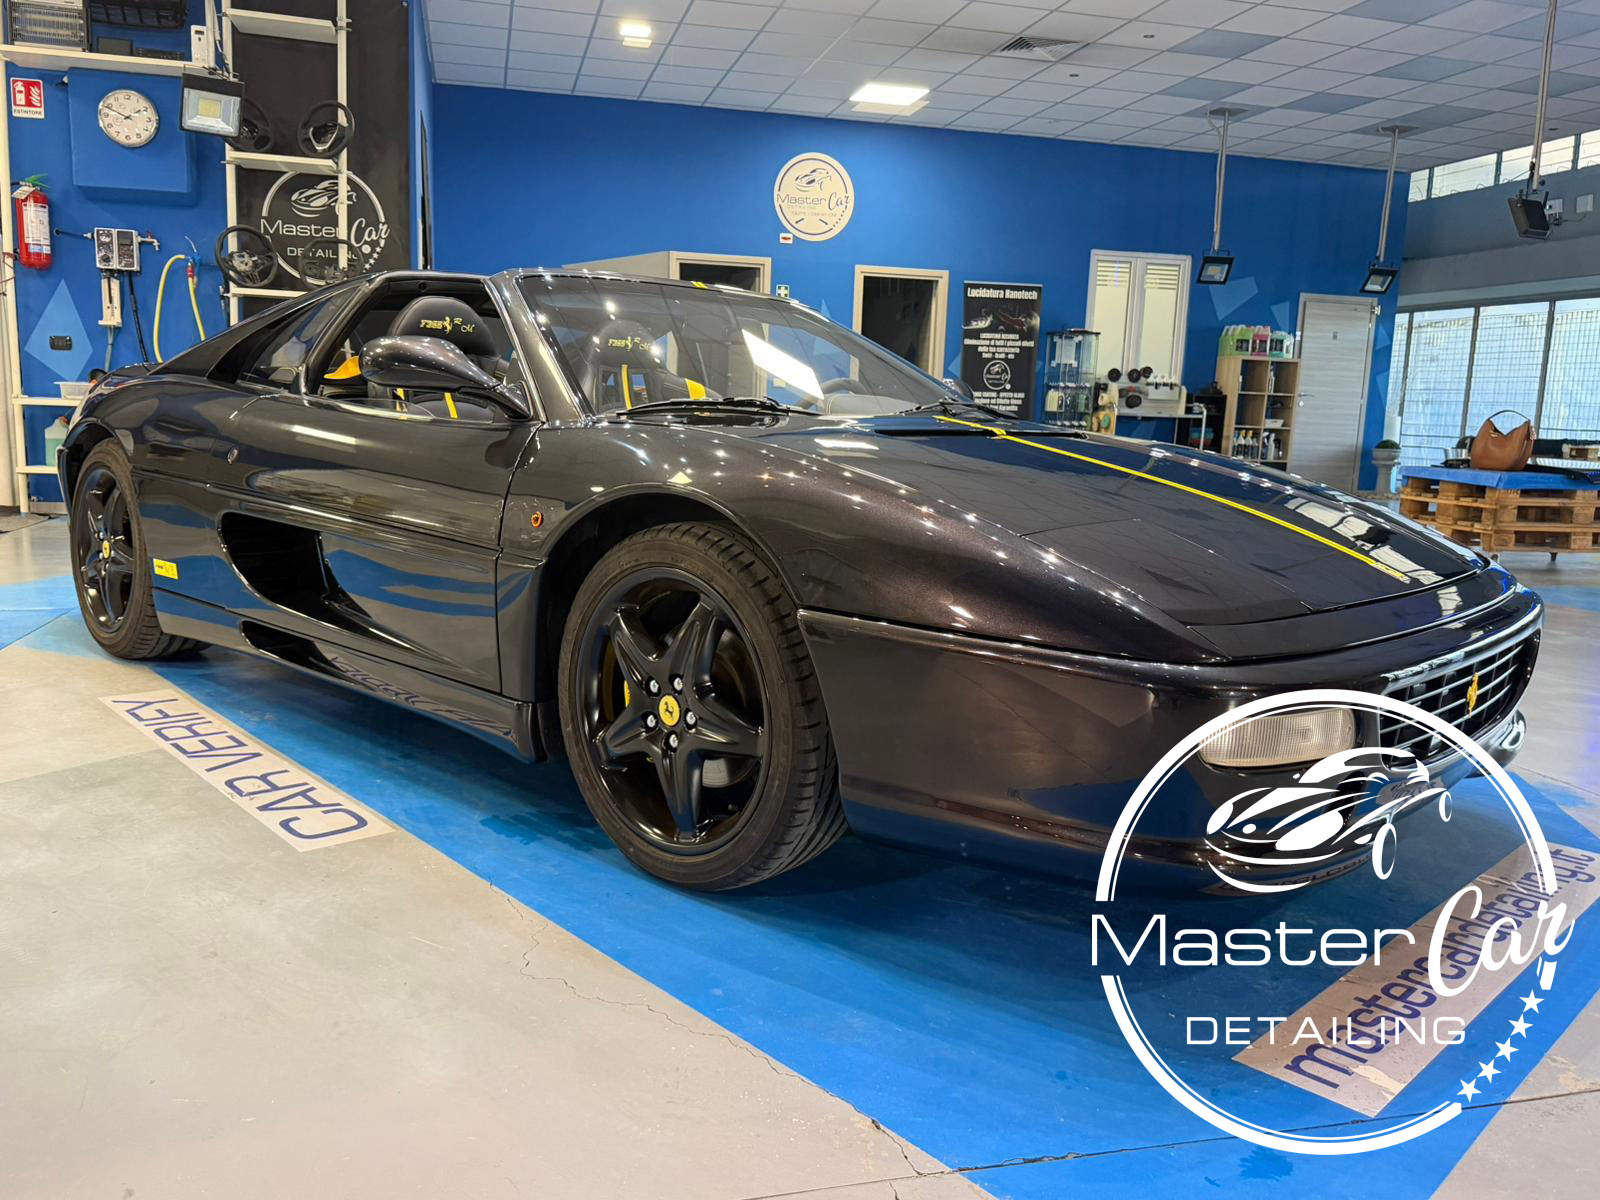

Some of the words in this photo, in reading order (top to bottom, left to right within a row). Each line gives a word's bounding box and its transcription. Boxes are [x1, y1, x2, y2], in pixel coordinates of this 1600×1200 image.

[13, 107, 42, 116] ESTINTORE
[776, 193, 826, 206] Master
[260, 218, 341, 238] Maste
[350, 217, 390, 248] Car
[286, 246, 359, 260] DEAIL
[967, 287, 1004, 299] Lucidatura
[1005, 288, 1038, 300] Nanotech
[111, 697, 264, 772] VERIFY
[224, 769, 368, 840] CAR
